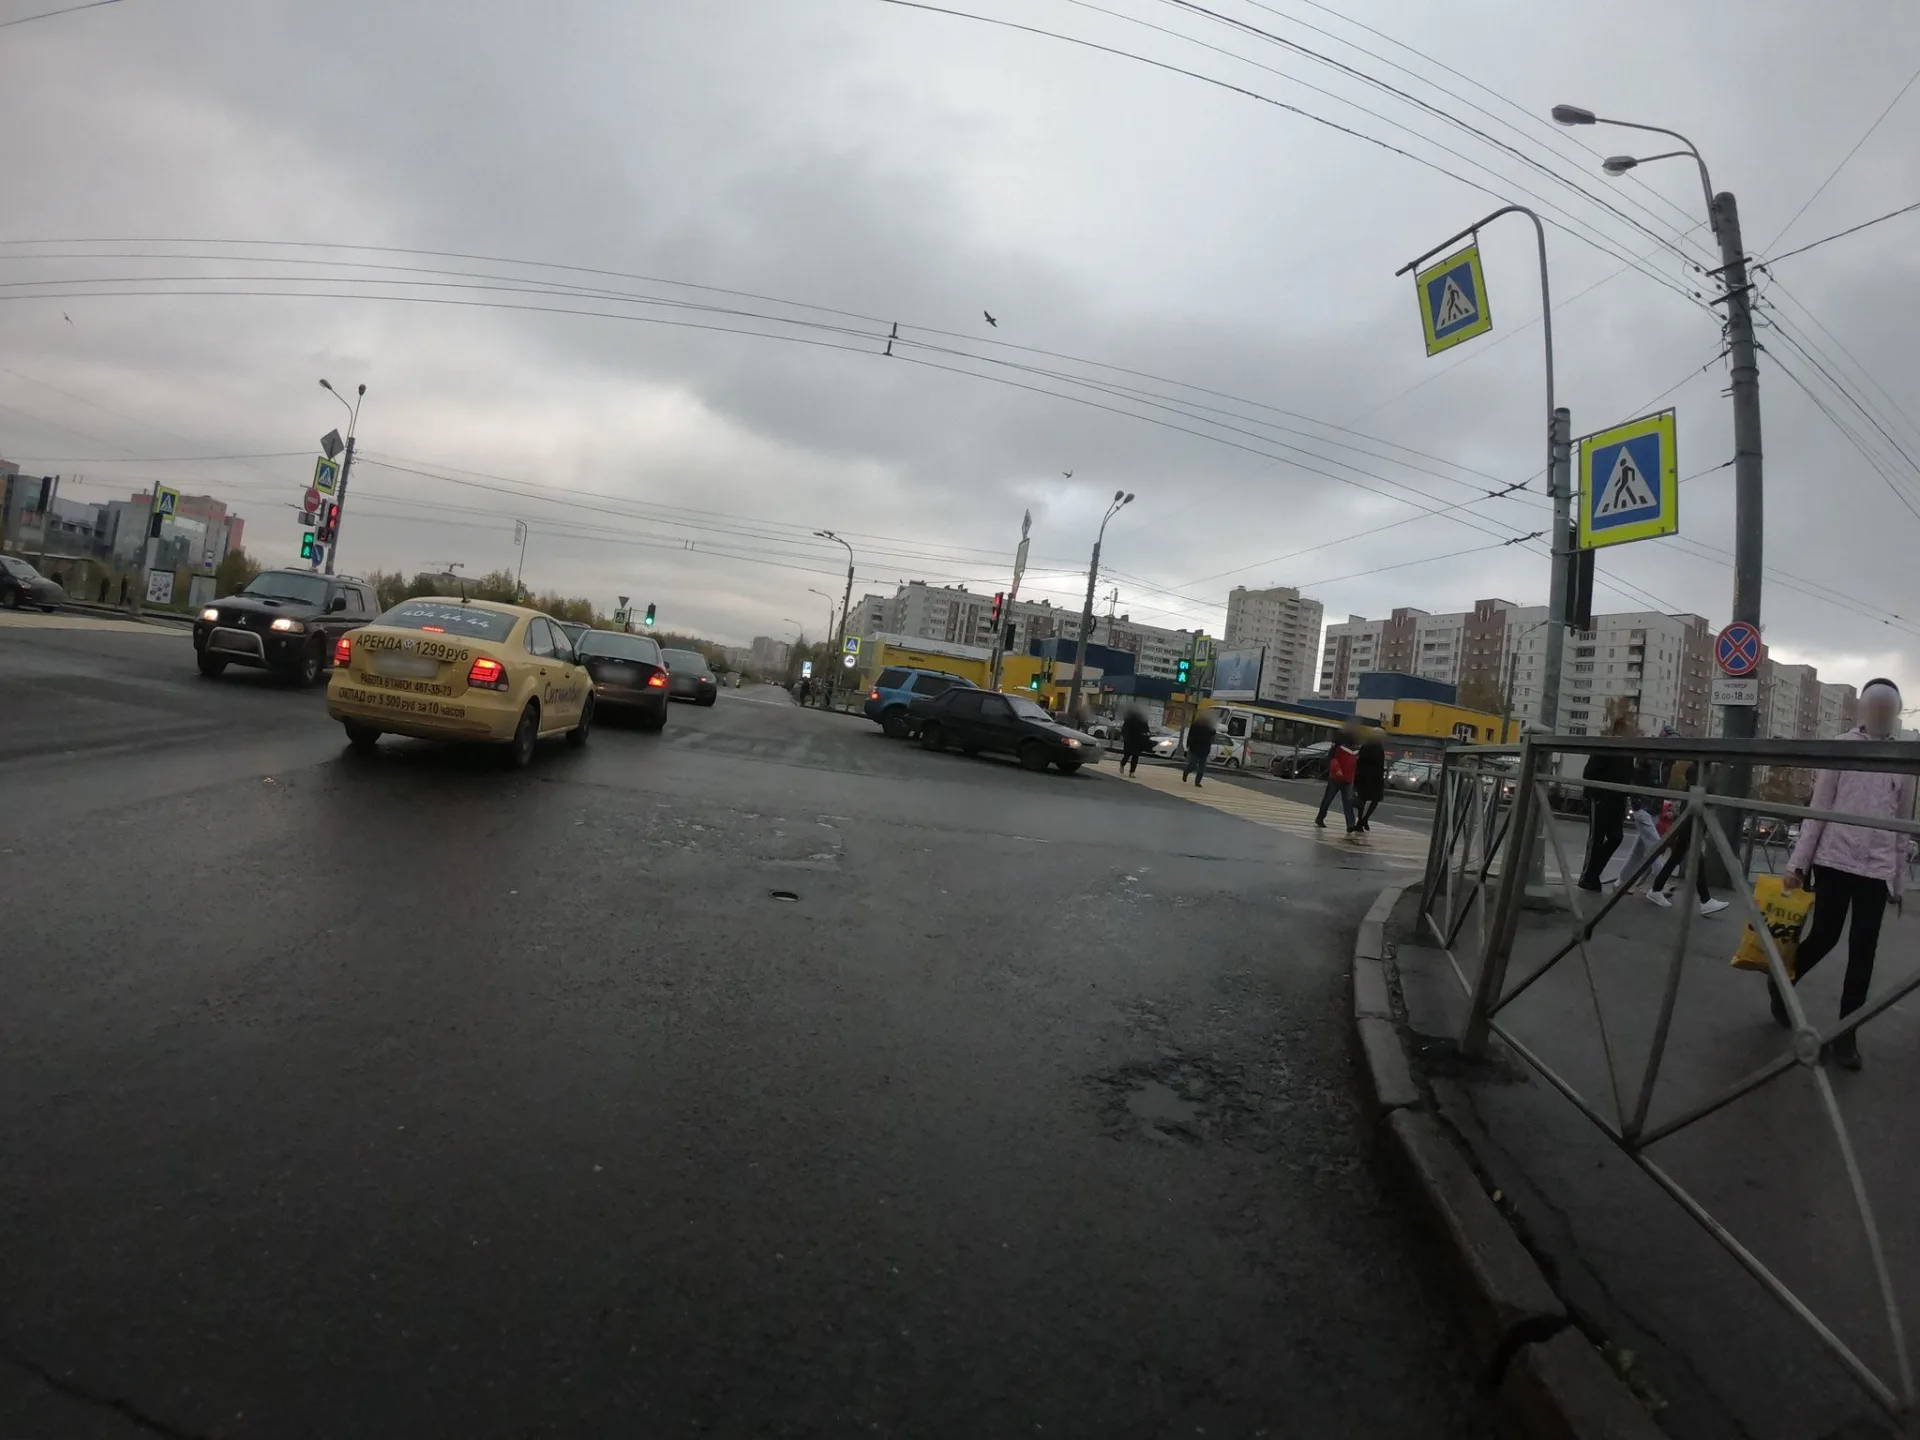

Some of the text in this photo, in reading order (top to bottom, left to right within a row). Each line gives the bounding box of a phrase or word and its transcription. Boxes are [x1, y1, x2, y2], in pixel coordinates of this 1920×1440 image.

[356, 633, 470, 661] АРЕНДА 1299 руб
[401, 699, 415, 711] руб
[429, 702, 439, 714] 10
